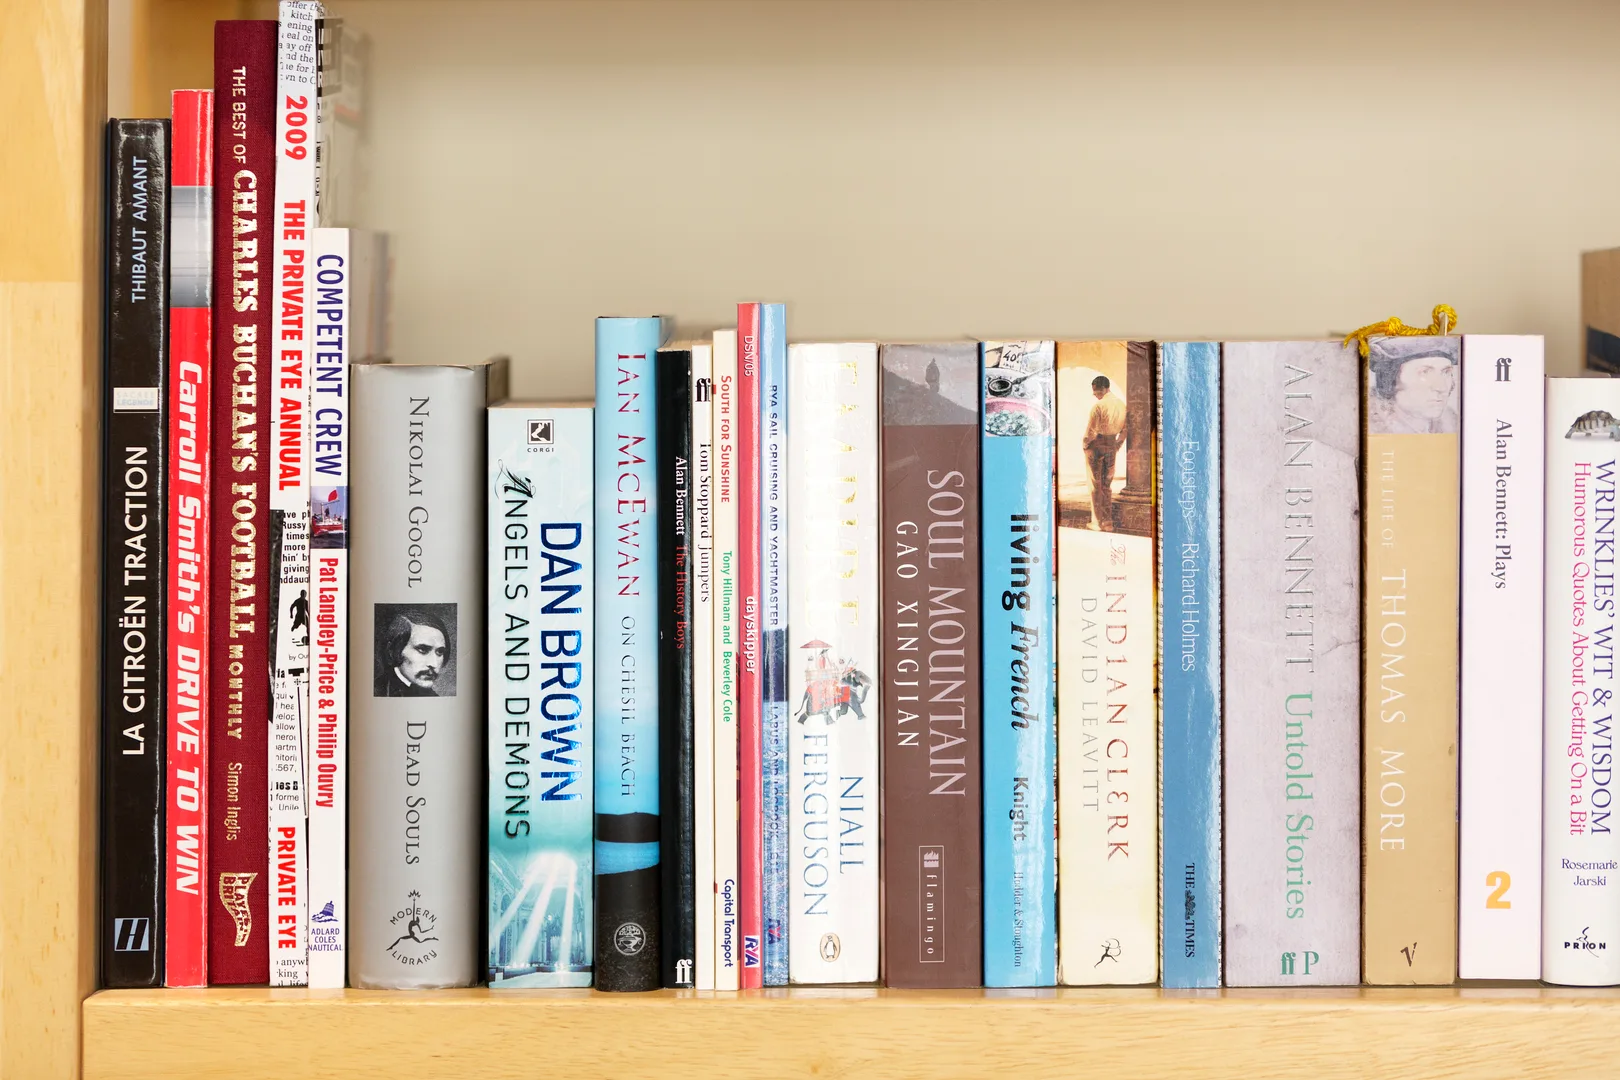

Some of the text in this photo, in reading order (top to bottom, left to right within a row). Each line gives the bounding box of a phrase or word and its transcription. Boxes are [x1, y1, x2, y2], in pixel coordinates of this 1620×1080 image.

[296, 63, 309, 72] for
[298, 44, 312, 53] off
[285, 95, 308, 161] 2009
[132, 157, 148, 303] THIBAUT AMANT
[278, 199, 305, 491] THE PRIVATE EYE ANNUAL
[315, 254, 343, 476] COMPETENT CREW
[617, 353, 647, 413] IAN
[743, 336, 754, 377] DSN/05
[1495, 357, 1512, 382] ff
[227, 66, 258, 740] THE BEST OF CHARLES BUCHAN'S FOOTBALL MONTHLY
[695, 377, 711, 402] ff
[721, 375, 732, 414] SOUTH
[408, 396, 430, 588] NIKOLAI GOGOL
[675, 456, 688, 536] Alan Bennett
[697, 476, 712, 539] Stoppard
[721, 445, 732, 503] SUNSHINE
[769, 385, 779, 625] RYA SAIL CRUISING AND YACHTMASTER
[1381, 450, 1394, 549] THE LIFE OF
[1491, 419, 1513, 589] Alan Bennett: Plays
[1110, 539, 1127, 566] The
[1177, 441, 1200, 672] Footsteps Richard Holmes
[1284, 363, 1315, 674] ALAN BENNETT
[118, 446, 148, 755] LA CITROËN TRACTION
[673, 544, 689, 649] The History Boys
[720, 551, 733, 575] Tony
[176, 360, 202, 895] Carroll Smith's DRIVE TO WIN
[494, 459, 536, 838] ANGELS AND DEMONS
[540, 522, 583, 801] DAN BROWN
[722, 628, 733, 645] and
[743, 596, 758, 674] dayskipper
[894, 521, 919, 747] GAO XINGJIAN
[927, 469, 967, 796] SOUL MOUNTAIN
[1001, 514, 1040, 730] living French
[1567, 462, 1592, 835] Humorous Quotes About Getting On a Bit
[1593, 624, 1614, 679] WIT
[316, 557, 339, 808] Pat Langley-Price & Philip Ouvry
[621, 616, 636, 797] ON CHESIL BEACH
[720, 651, 733, 697] Beverley
[722, 699, 733, 722] Cole
[1081, 597, 1099, 811] DAVID LEAVITT
[1380, 568, 1406, 850] THOMAS MORE
[1592, 688, 1613, 707] &
[224, 762, 242, 841] Simon Inglis
[405, 720, 427, 865] DEAD SOULS
[1009, 777, 1029, 841] Knight
[1285, 692, 1314, 919] Untold Stories
[1591, 714, 1613, 835] WISDOM
[803, 734, 829, 916] FERGUSON
[839, 776, 865, 874] NIALL
[1561, 858, 1618, 870] Rosemarie
[278, 827, 296, 949] PRIVATE EYE
[389, 907, 438, 925] MODERN
[924, 874, 938, 954] flamingo
[1013, 871, 1024, 907] Hodder
[1185, 862, 1196, 958] THE TIMES
[1485, 870, 1511, 909] 2
[1573, 875, 1607, 886] Jarski
[391, 949, 438, 966] LIBRARY
[721, 879, 735, 967] Capital Transport
[744, 936, 759, 967] RYA
[1012, 918, 1025, 967] Stoughton
[1280, 951, 1319, 975] ff P
[1564, 941, 1607, 950] PRION
[675, 958, 693, 984] ff
